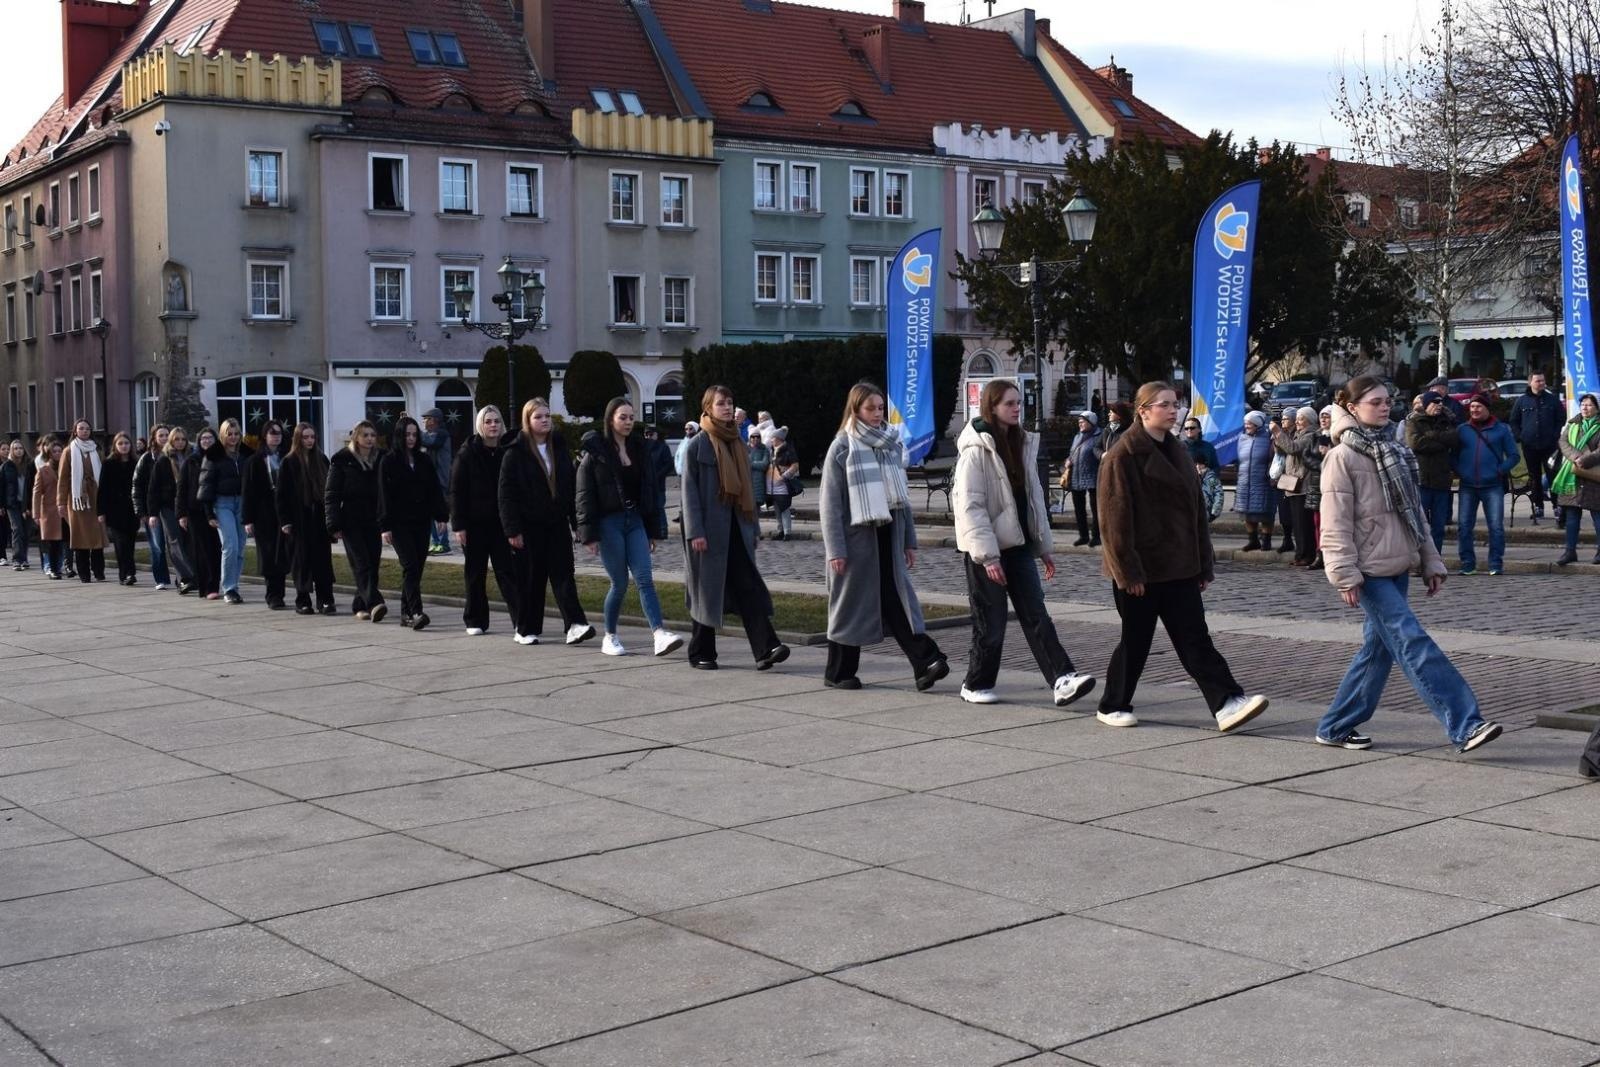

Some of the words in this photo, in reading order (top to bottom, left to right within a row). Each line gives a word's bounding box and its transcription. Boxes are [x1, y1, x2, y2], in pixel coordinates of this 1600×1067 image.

[919, 298, 930, 349] POWIAT
[1230, 264, 1245, 327] POWIAT
[906, 299, 919, 419] WODZISŁAWSKI
[1213, 264, 1233, 409] WODZISŁAWSKI
[194, 366, 206, 376] 13
